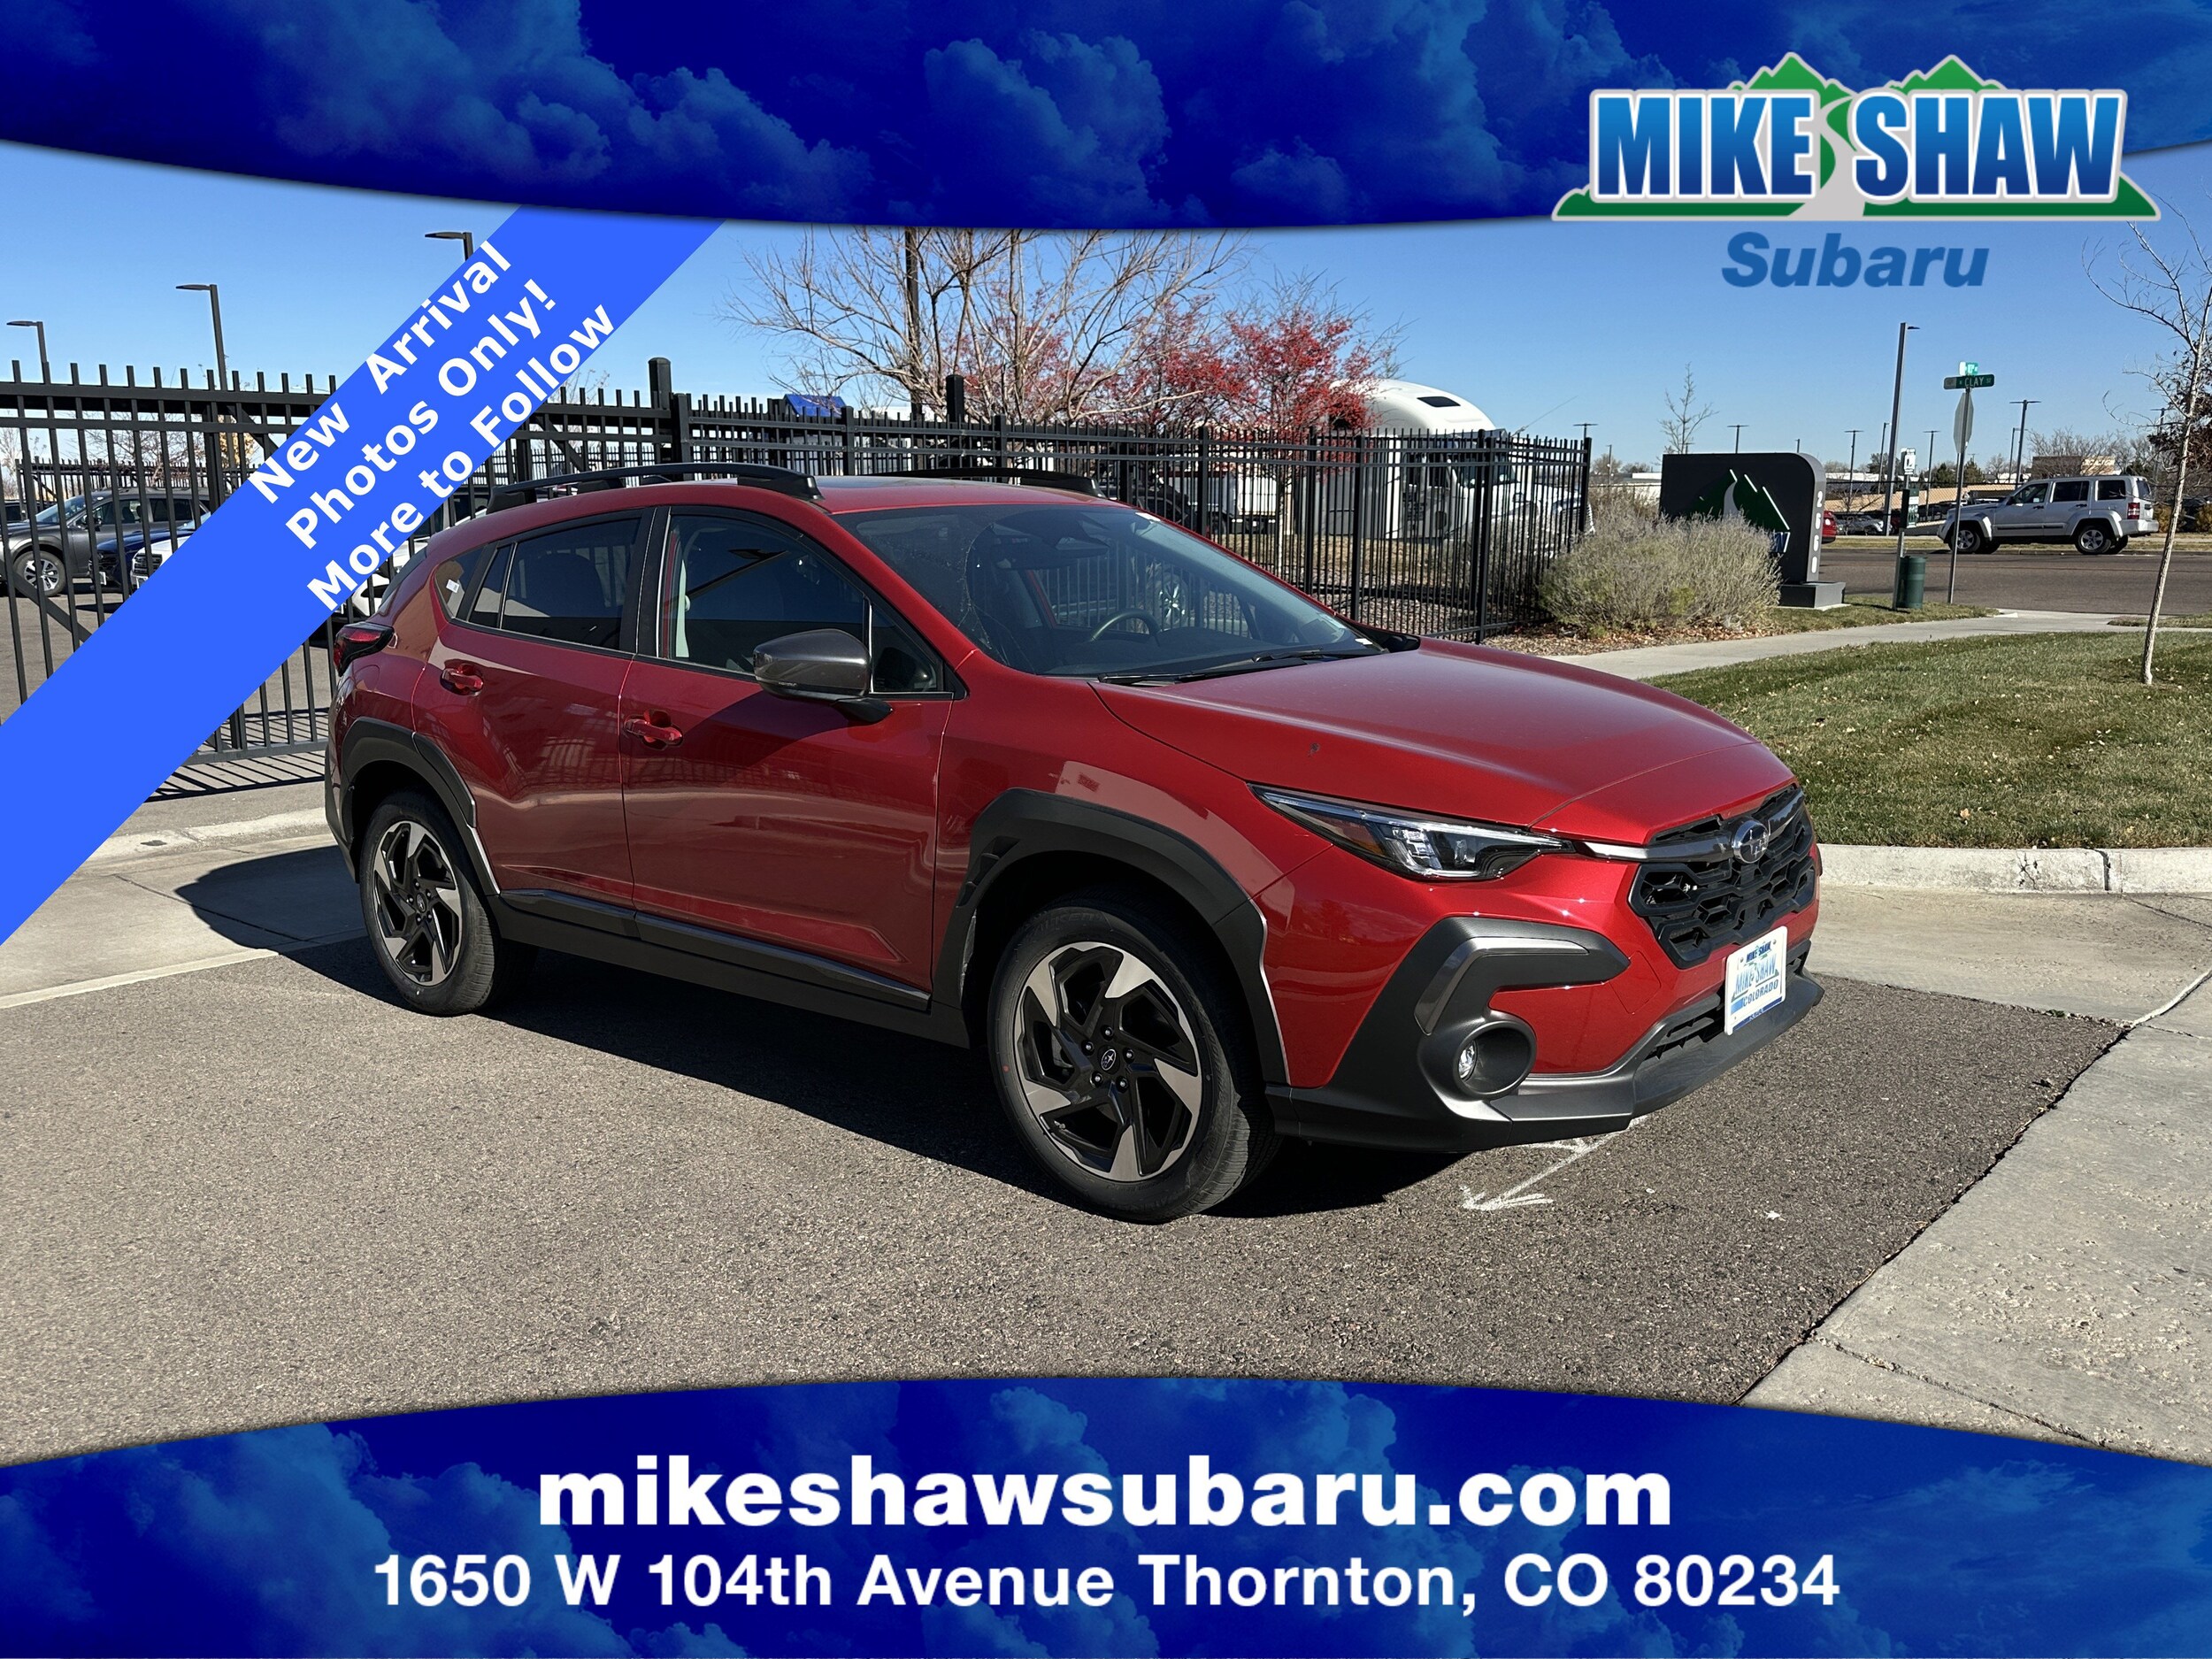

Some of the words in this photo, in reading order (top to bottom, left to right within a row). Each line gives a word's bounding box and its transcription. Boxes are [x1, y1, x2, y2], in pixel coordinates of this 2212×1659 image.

[1964, 377, 1985, 388] CLAY
[1747, 949, 1758, 964] MIKE
[1735, 972, 1752, 994] MIKE
[1755, 953, 1777, 983] SHAW
[1743, 979, 1778, 1007] COLORADO
